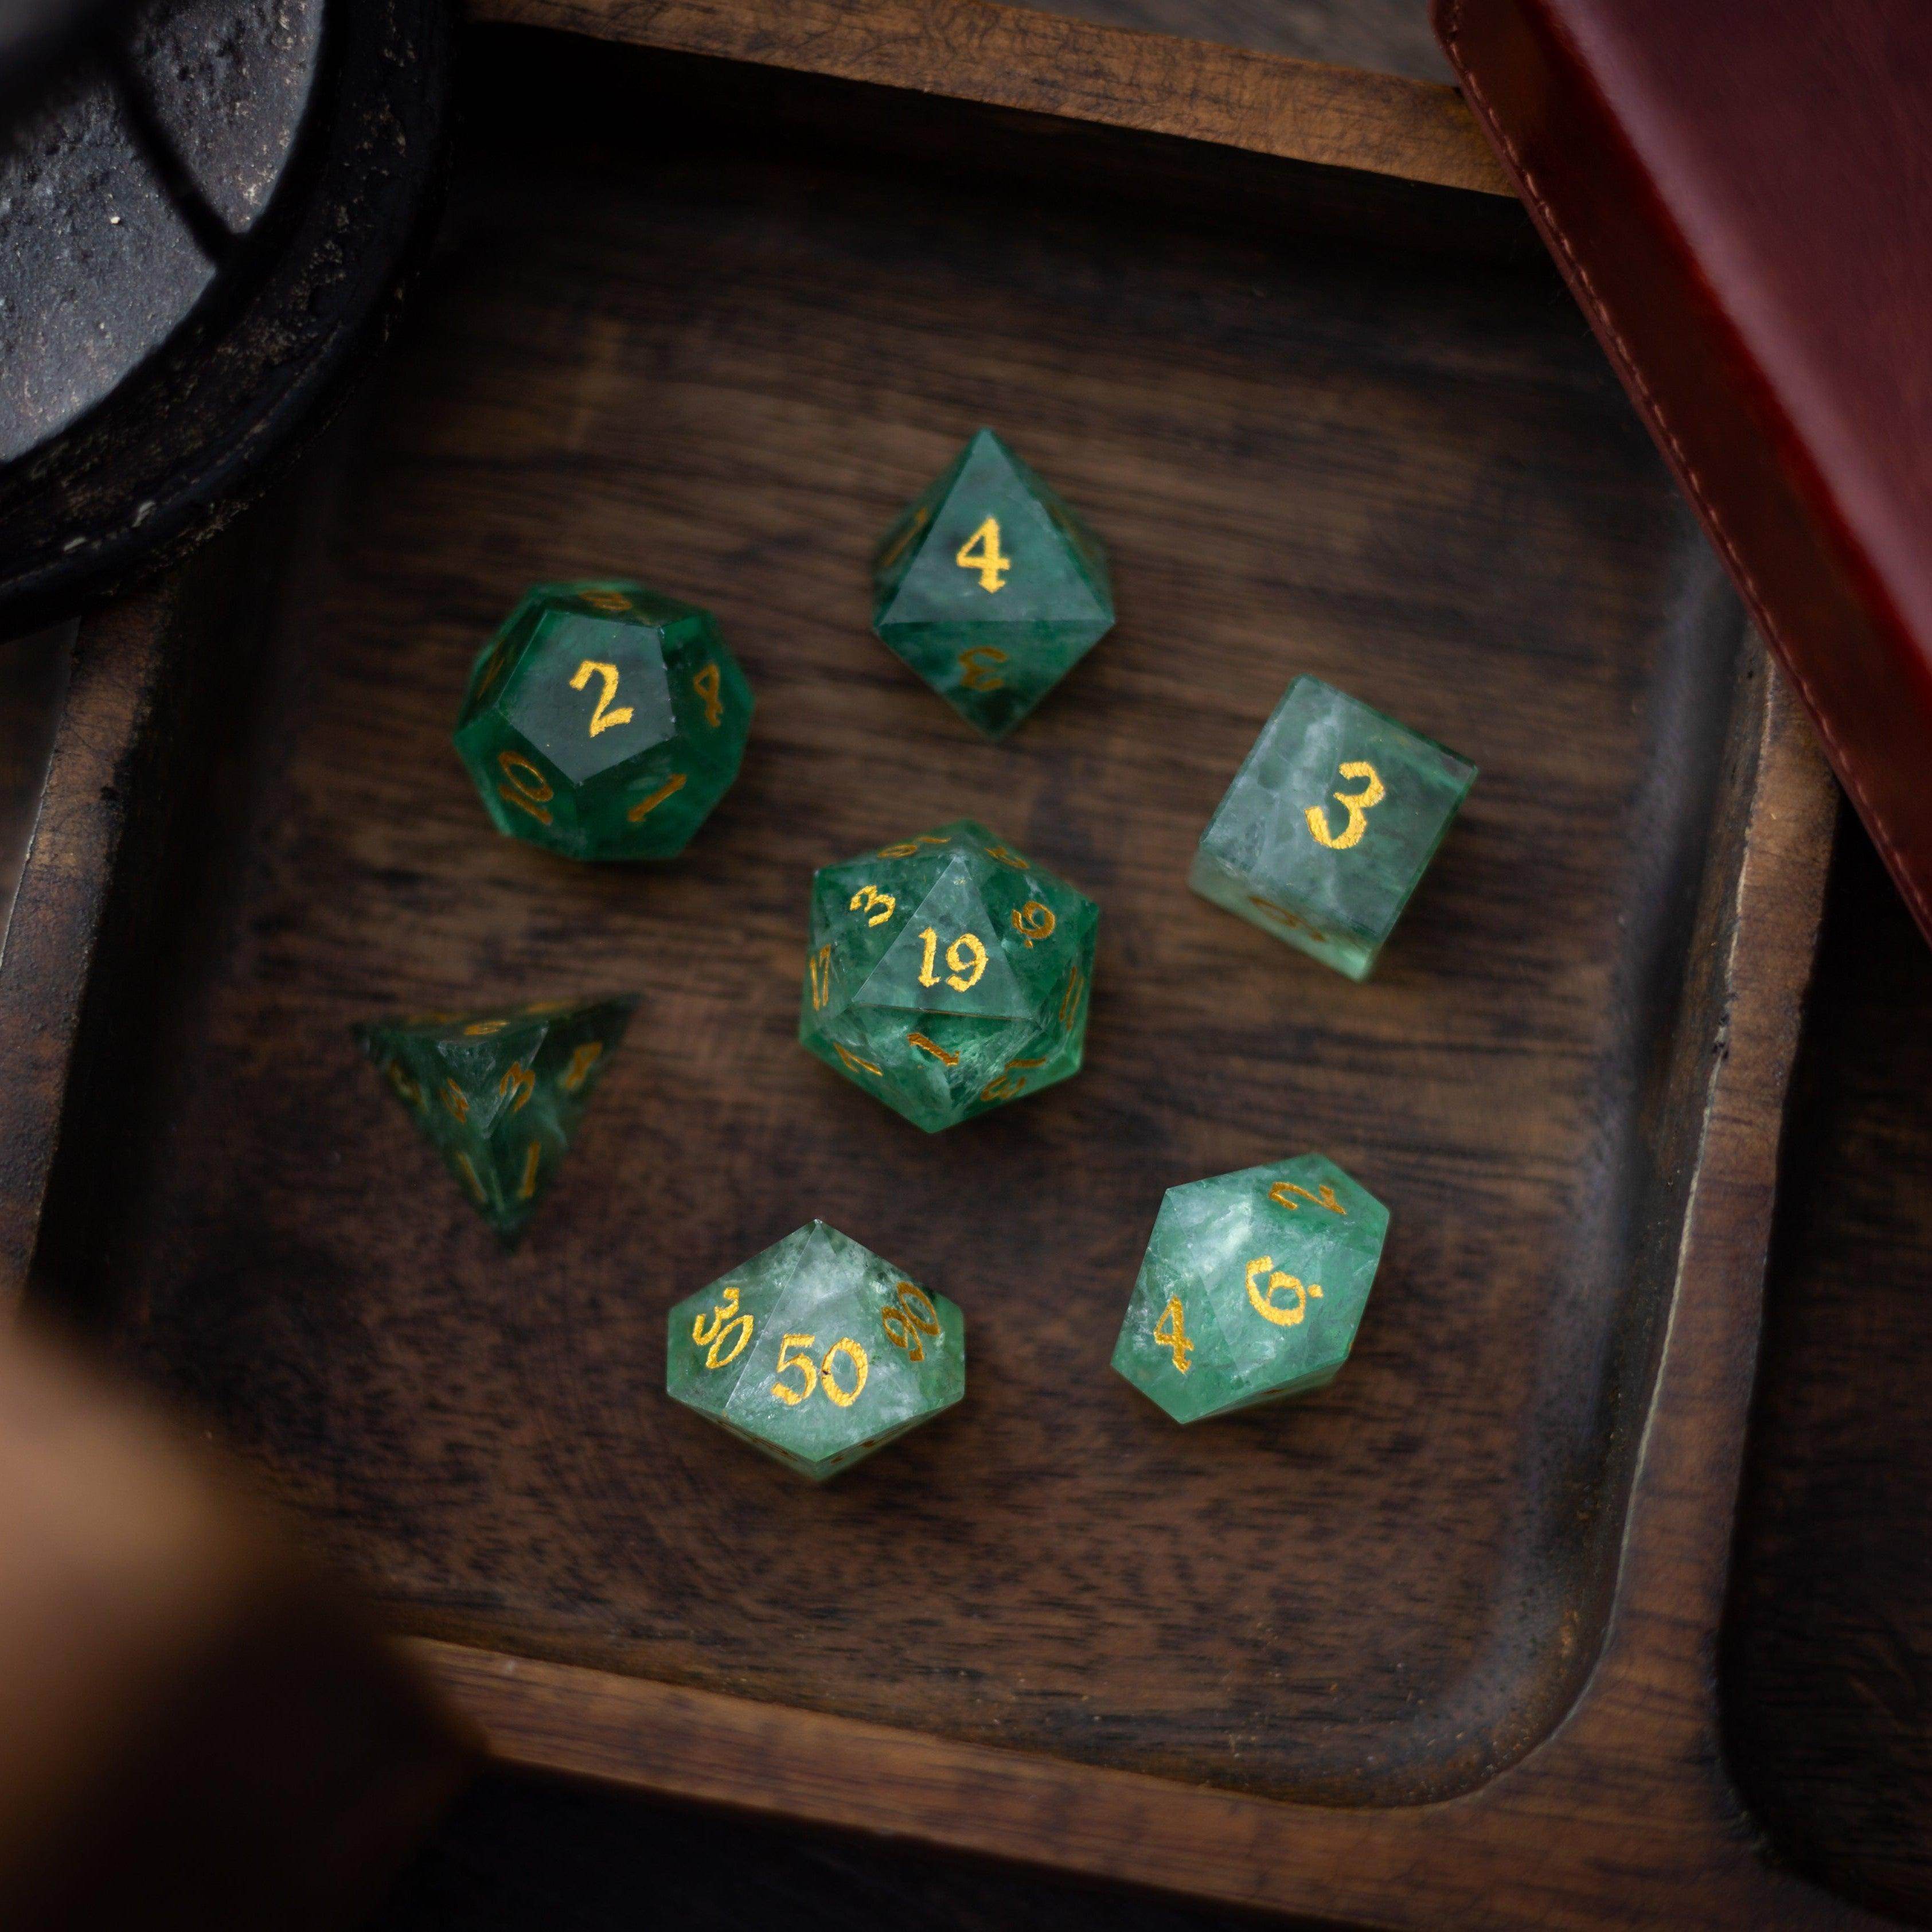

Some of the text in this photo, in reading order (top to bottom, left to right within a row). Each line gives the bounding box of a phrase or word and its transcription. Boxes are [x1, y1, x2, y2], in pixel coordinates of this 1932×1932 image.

[956, 517, 1010, 594] 4
[569, 659, 634, 737] 2
[1304, 761, 1385, 850] 3
[849, 885, 896, 927] 3
[918, 927, 989, 993] 19
[1268, 1181, 1346, 1215] 2
[691, 1287, 754, 1369] 30
[881, 1281, 941, 1363] 90
[1153, 1295, 1195, 1373] 4
[770, 1333, 869, 1407] 50
